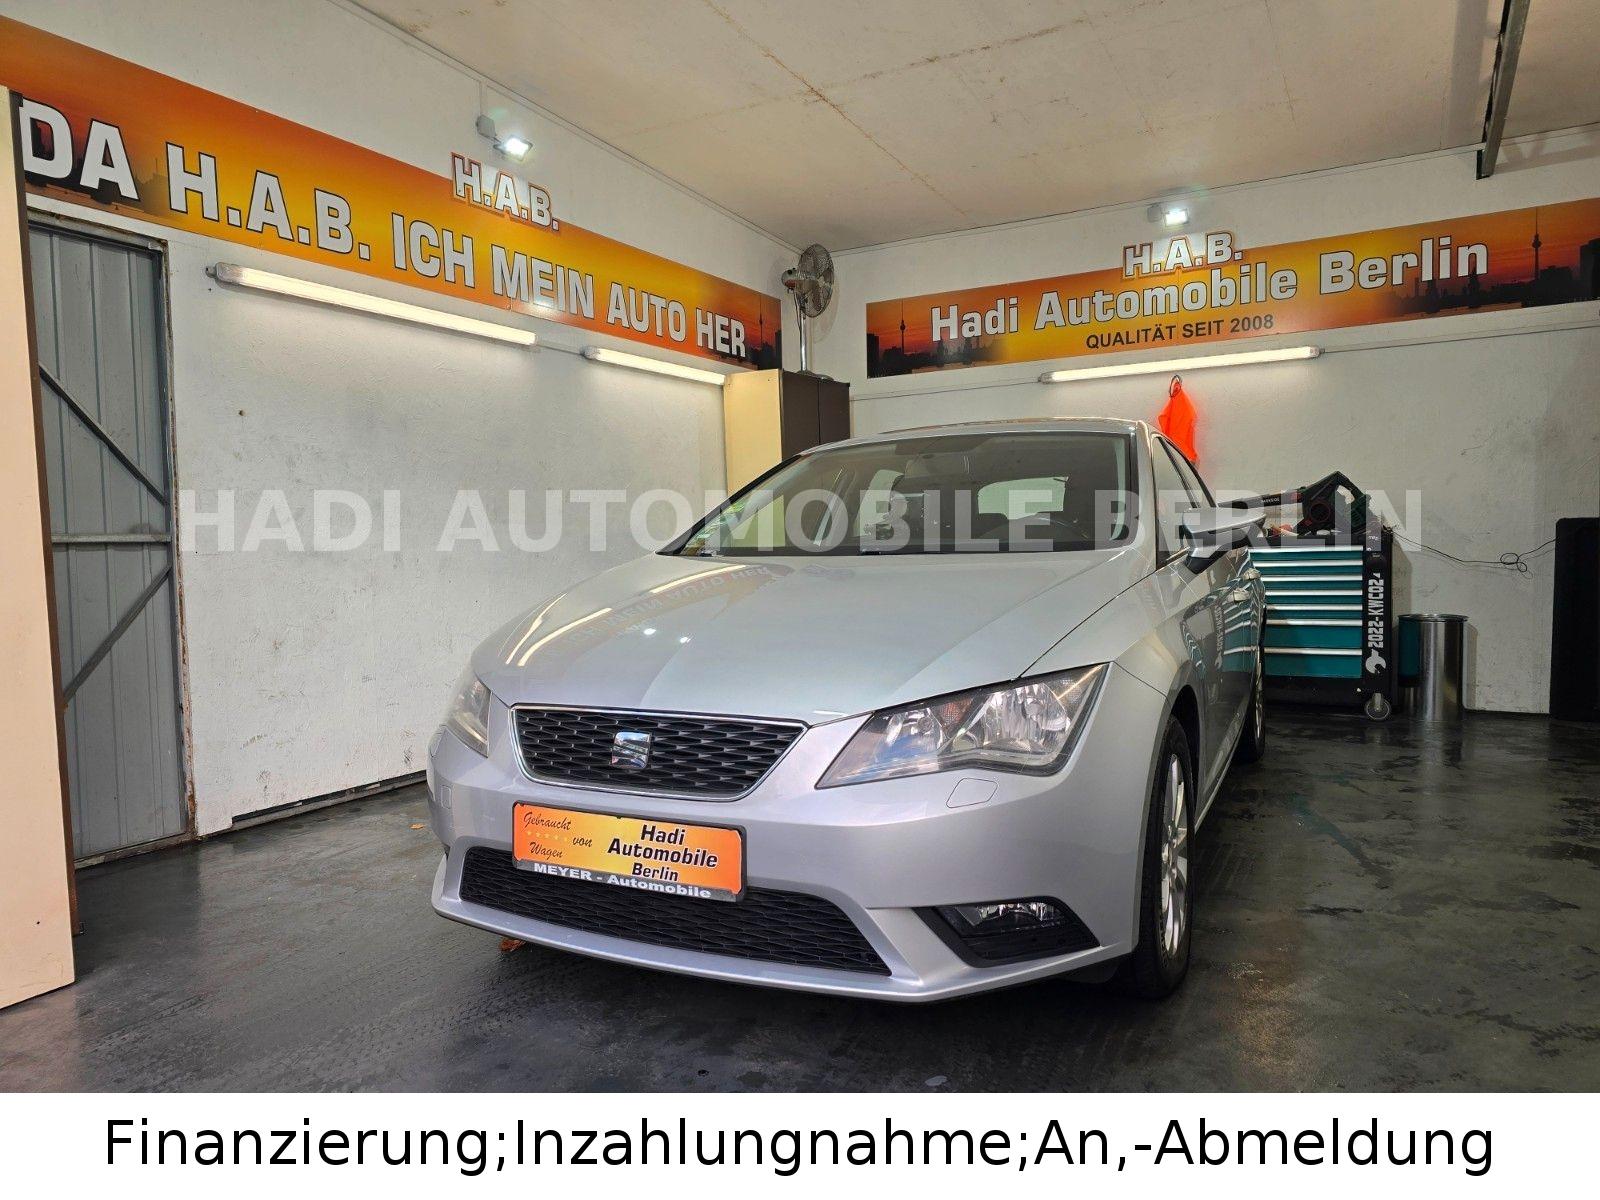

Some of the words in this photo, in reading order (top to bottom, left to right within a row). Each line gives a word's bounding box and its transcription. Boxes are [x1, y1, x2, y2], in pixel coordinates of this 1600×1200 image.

[453, 154, 559, 231] H.A.B.
[18, 98, 140, 201] DA
[166, 142, 371, 261] H.A.B.
[391, 211, 476, 289] ICH
[491, 244, 594, 319] MEIN
[607, 282, 686, 342] AUTO
[696, 307, 746, 358] HER
[1123, 231, 1243, 277] H.A.B.
[931, 297, 1018, 341] Hadi
[1034, 262, 1297, 330] Automobile
[1320, 235, 1488, 295] Berlin
[1086, 324, 1176, 349] QUALITÄT
[1182, 320, 1224, 338] SEIT
[1230, 314, 1274, 333] 2008
[524, 811, 572, 831] Gebraucht
[640, 824, 686, 846] Hadi
[529, 841, 563, 860] Wagen
[572, 836, 593, 848] von
[607, 838, 719, 868] Automobile
[534, 863, 592, 881] MEYER
[607, 874, 712, 899] Automobile
[632, 862, 679, 882] Berlin
